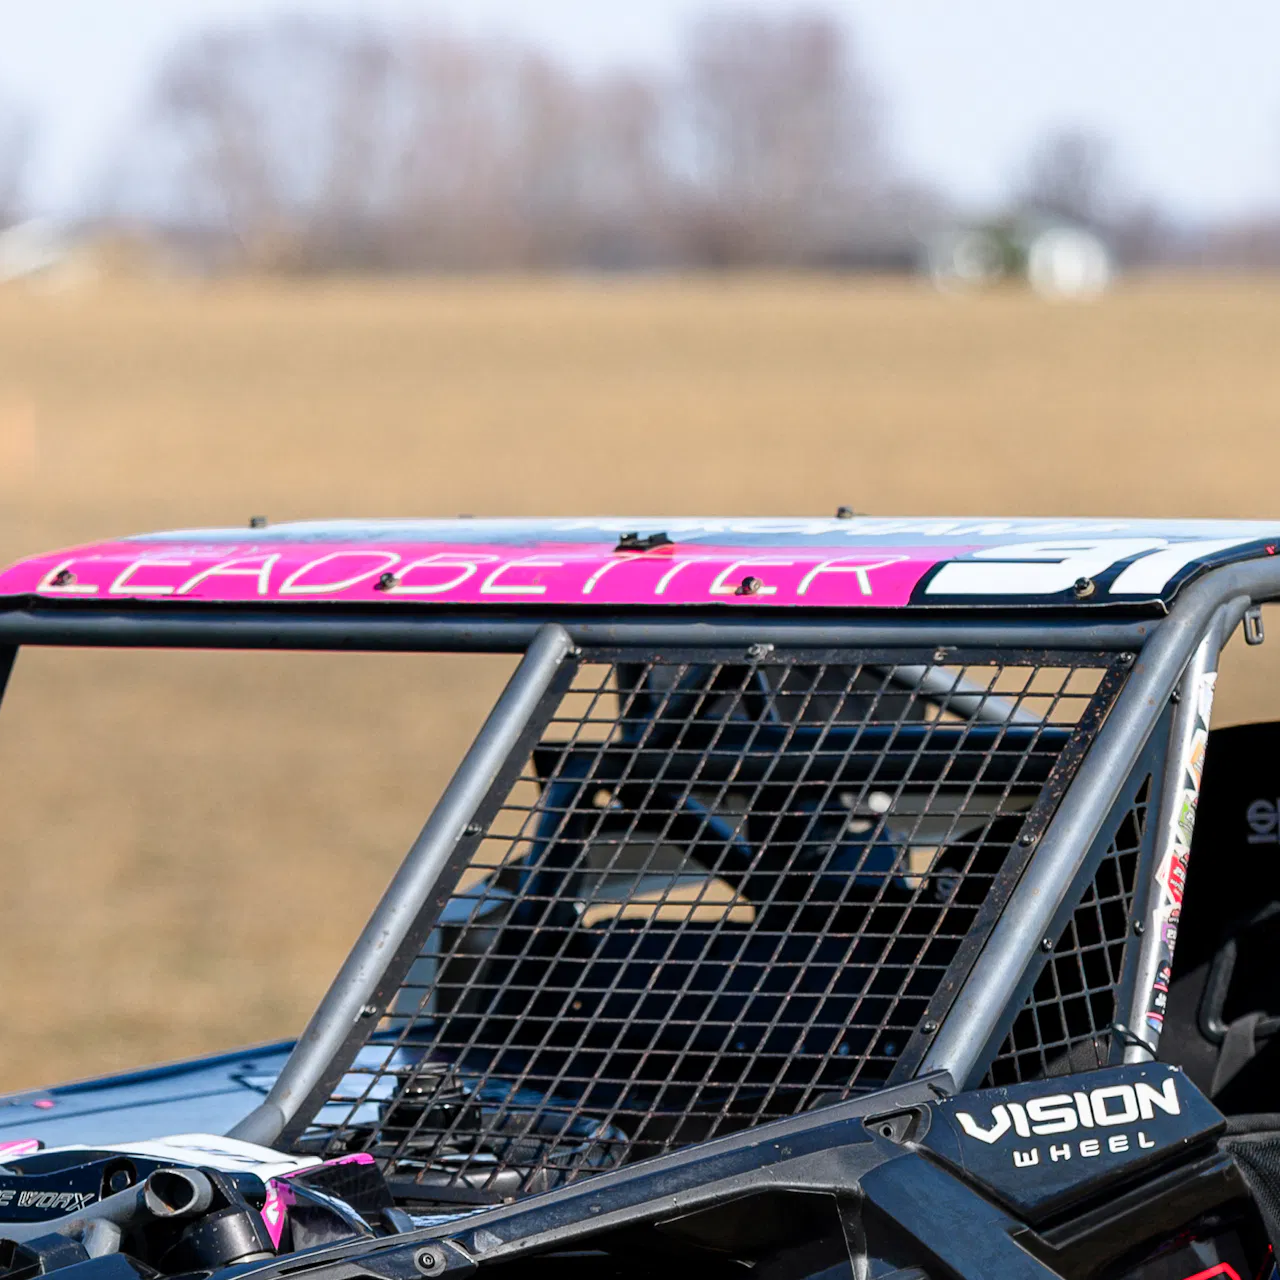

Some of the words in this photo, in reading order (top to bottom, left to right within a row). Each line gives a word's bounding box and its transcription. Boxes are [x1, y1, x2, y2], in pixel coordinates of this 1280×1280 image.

[35, 550, 912, 597] LEADBETTER
[923, 537, 1256, 596] 91
[955, 1077, 1181, 1145] VISION
[1012, 1131, 1156, 1168] WHEEL
[17, 1190, 95, 1212] WORX
